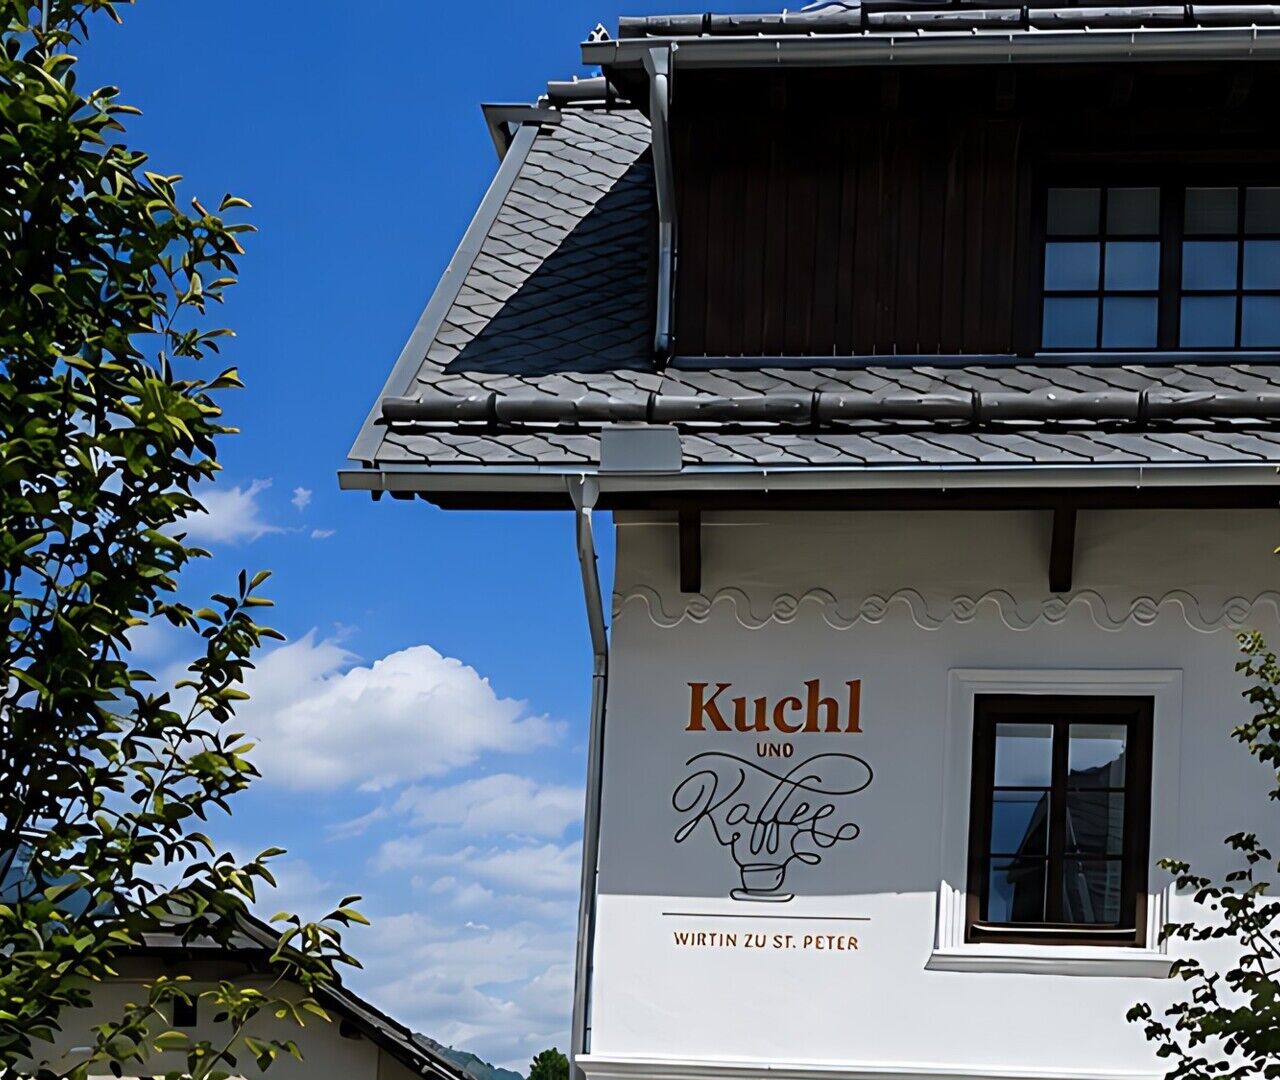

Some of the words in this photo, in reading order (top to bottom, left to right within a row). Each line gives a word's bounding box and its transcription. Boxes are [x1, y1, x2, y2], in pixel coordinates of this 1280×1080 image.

[685, 679, 863, 733] Kuchl
[672, 752, 873, 855] Kaffee
[673, 932, 737, 947] WIRTIN
[744, 933, 767, 948] ZU
[773, 934, 796, 949] ST.
[803, 935, 858, 950] PETER
